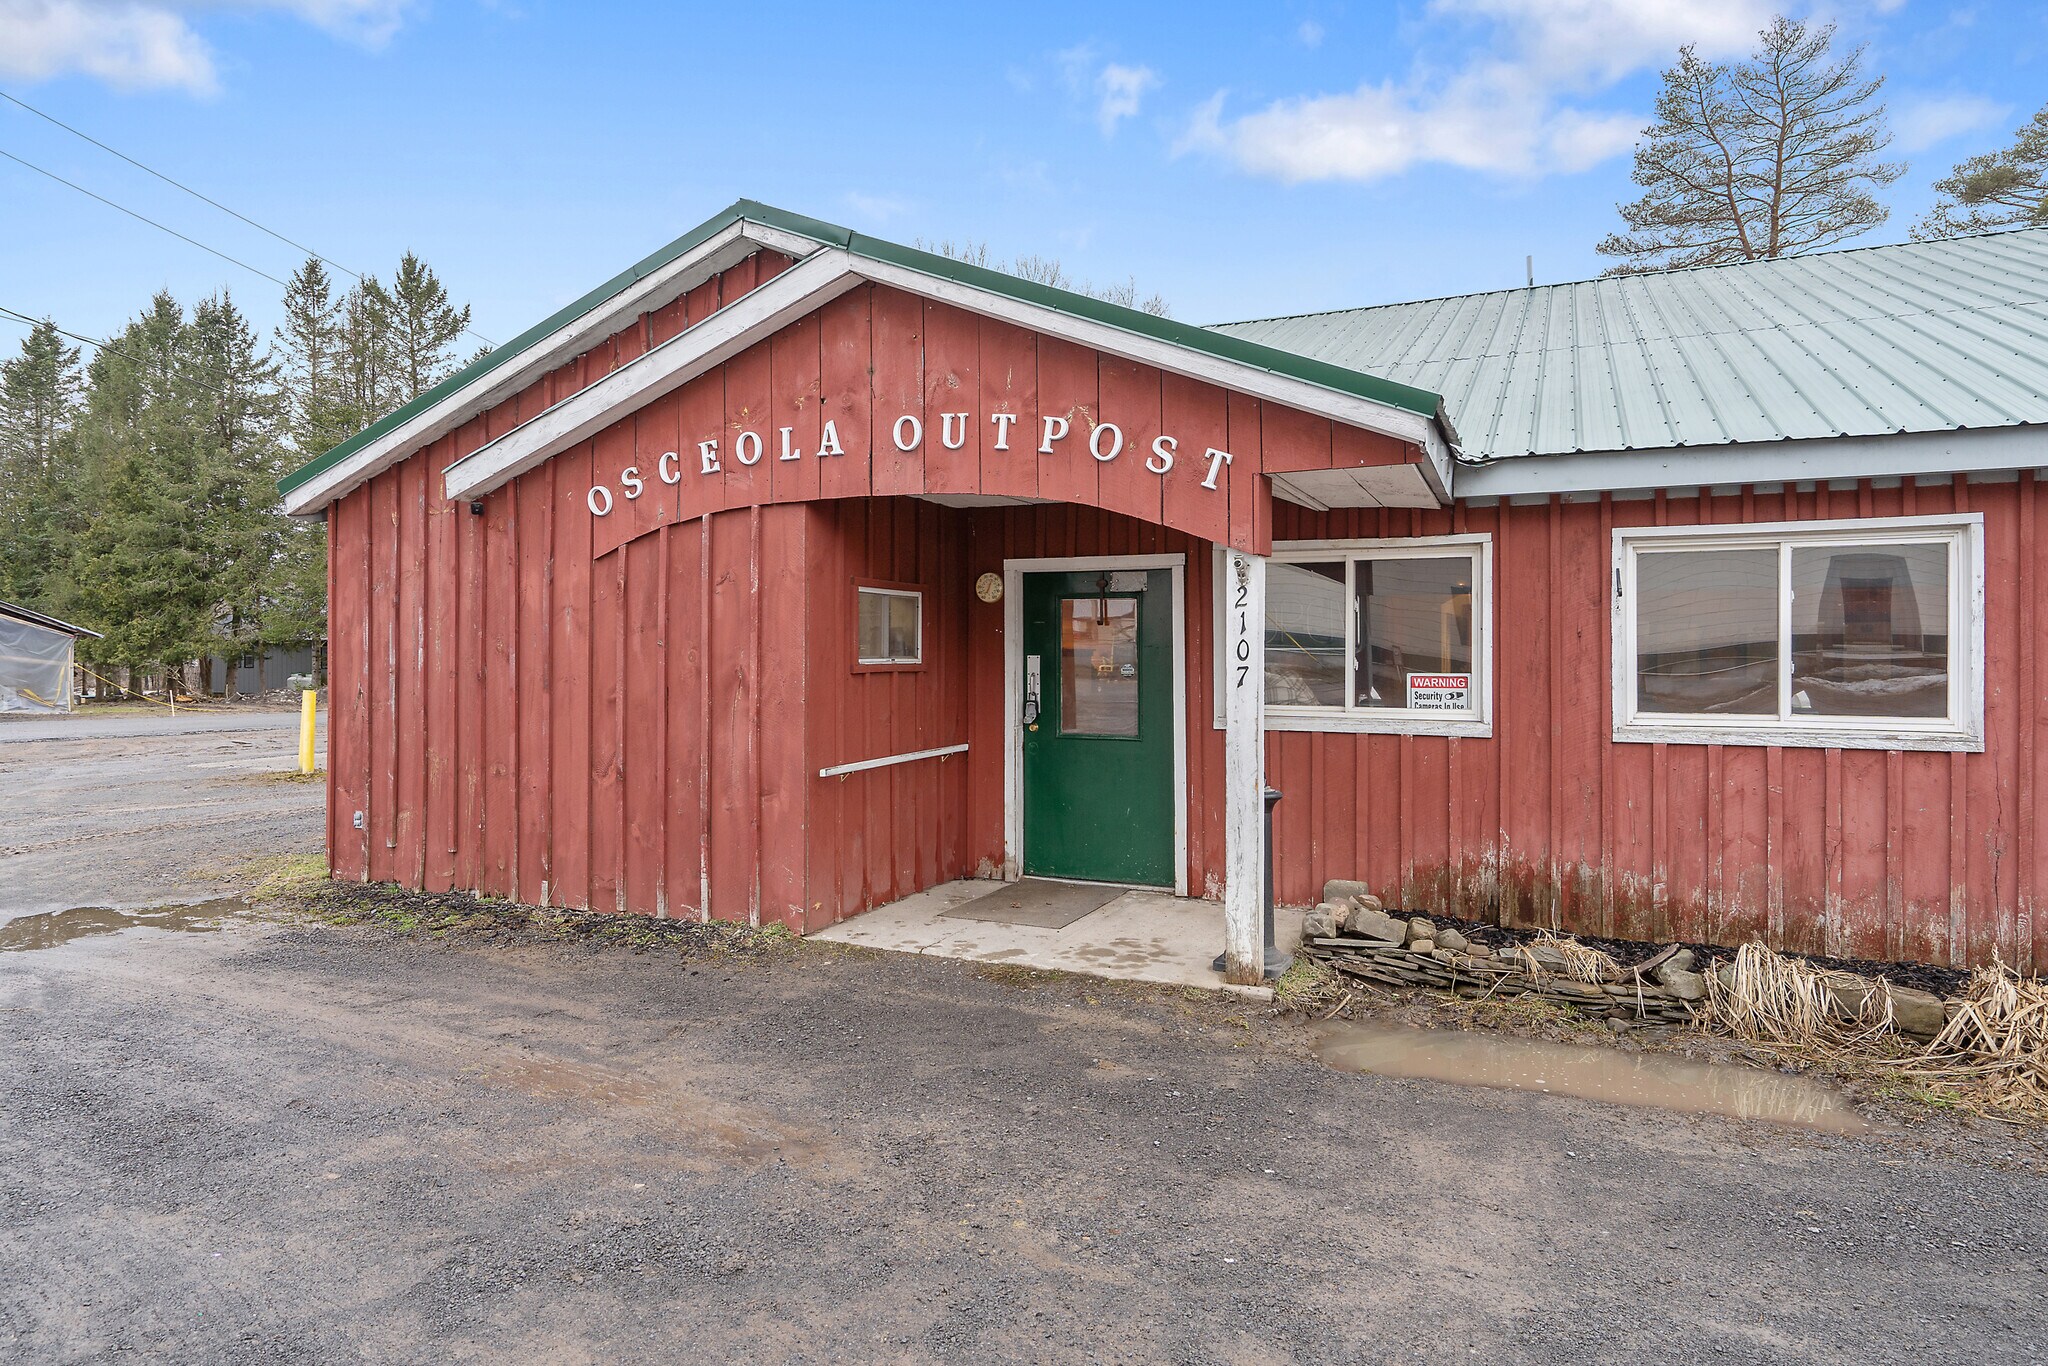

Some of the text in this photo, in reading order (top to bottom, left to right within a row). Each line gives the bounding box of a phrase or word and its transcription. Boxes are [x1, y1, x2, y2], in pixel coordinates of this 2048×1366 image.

[587, 412, 1233, 516] OSCEOLA OUTPOST
[1235, 585, 1249, 688] 2107
[1414, 678, 1466, 687] WARNING
[1414, 691, 1443, 702] Security
